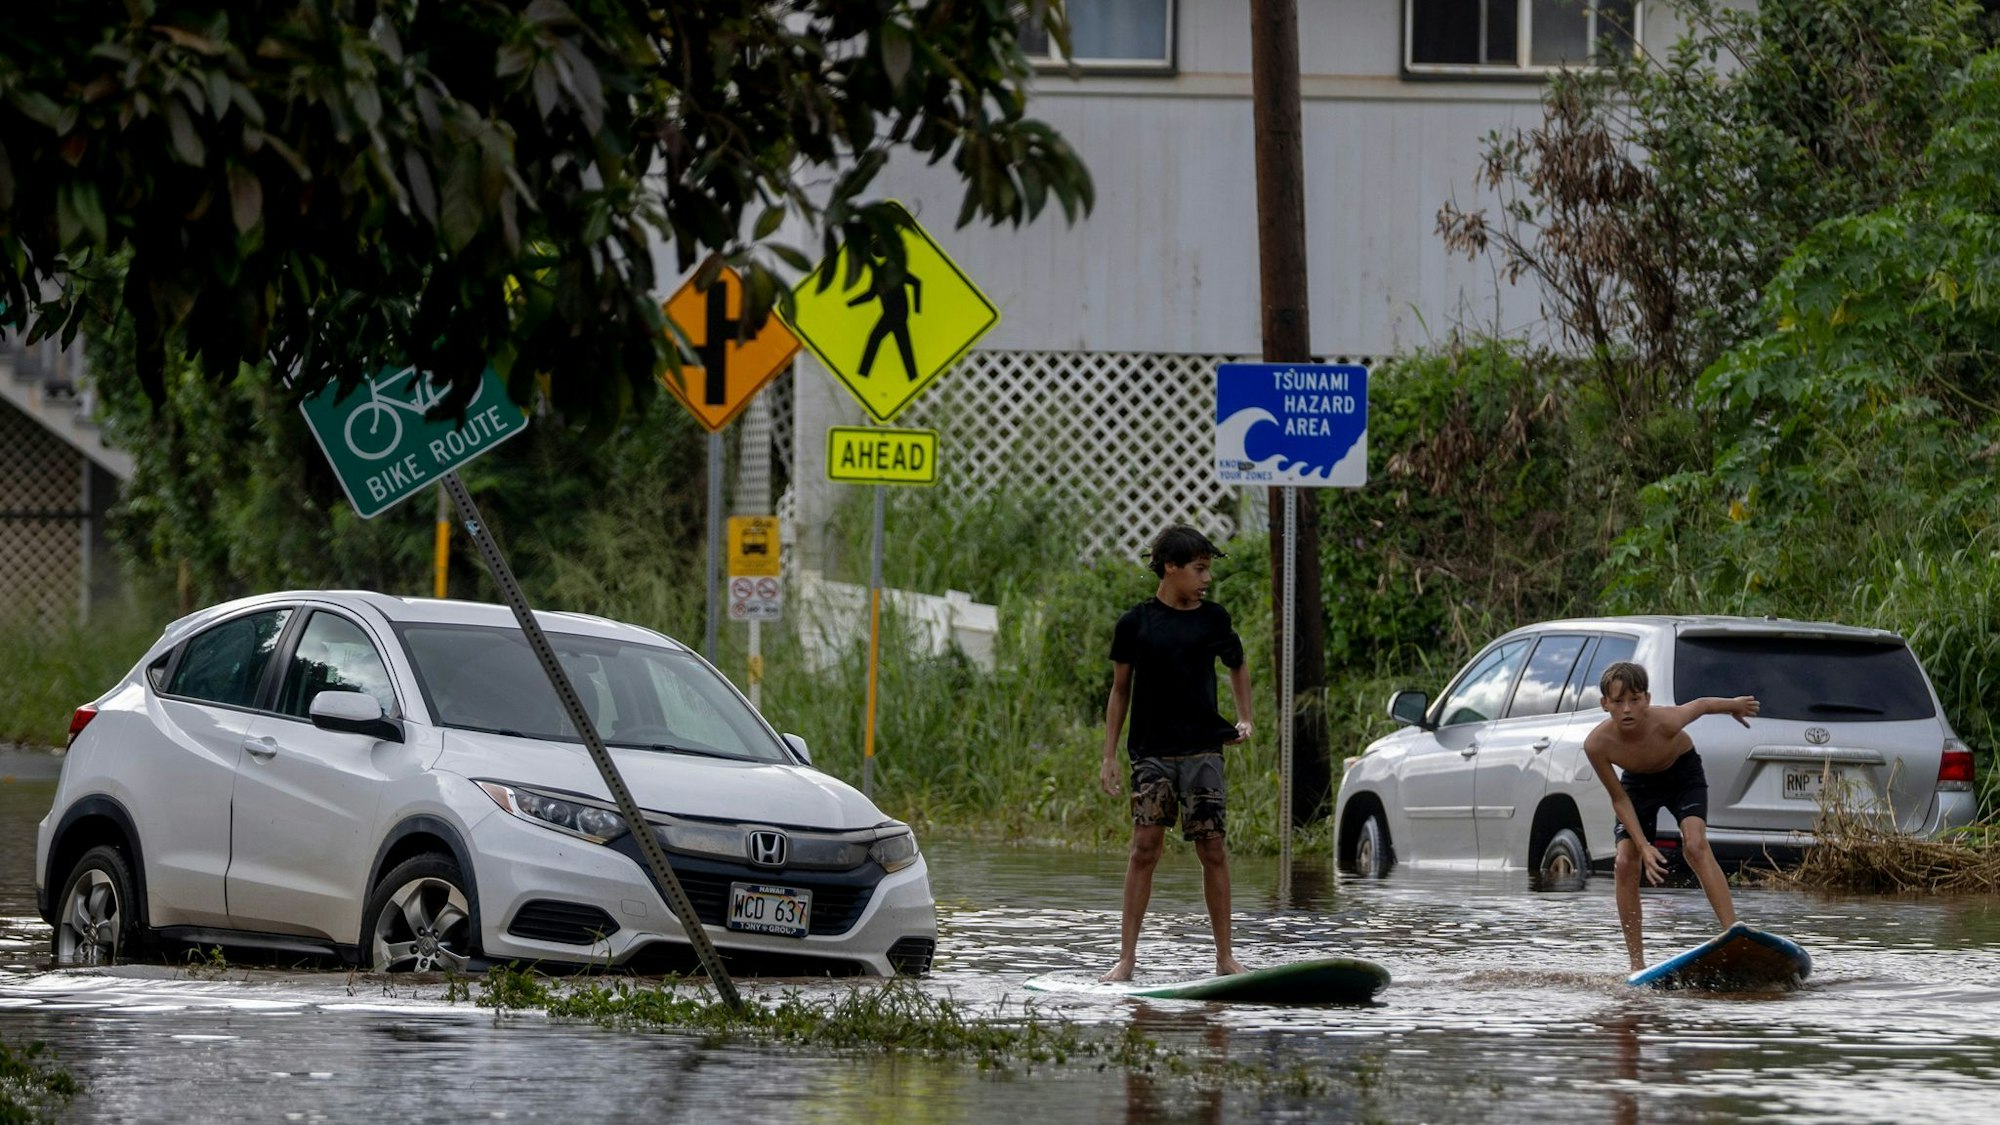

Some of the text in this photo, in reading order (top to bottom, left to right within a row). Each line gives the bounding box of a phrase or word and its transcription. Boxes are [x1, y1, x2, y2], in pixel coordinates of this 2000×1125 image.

[1273, 372, 1349, 391] TSUNAMI
[1284, 395, 1355, 414] HAZARD
[1285, 418, 1331, 436] AREA
[365, 404, 508, 502] BIKE ROUTE
[841, 440, 925, 471] AHEAD
[1246, 471, 1273, 480] ZONES
[1787, 773, 1810, 791] RNP
[759, 886, 785, 895] HAWAII
[734, 894, 807, 925] WCD 637
